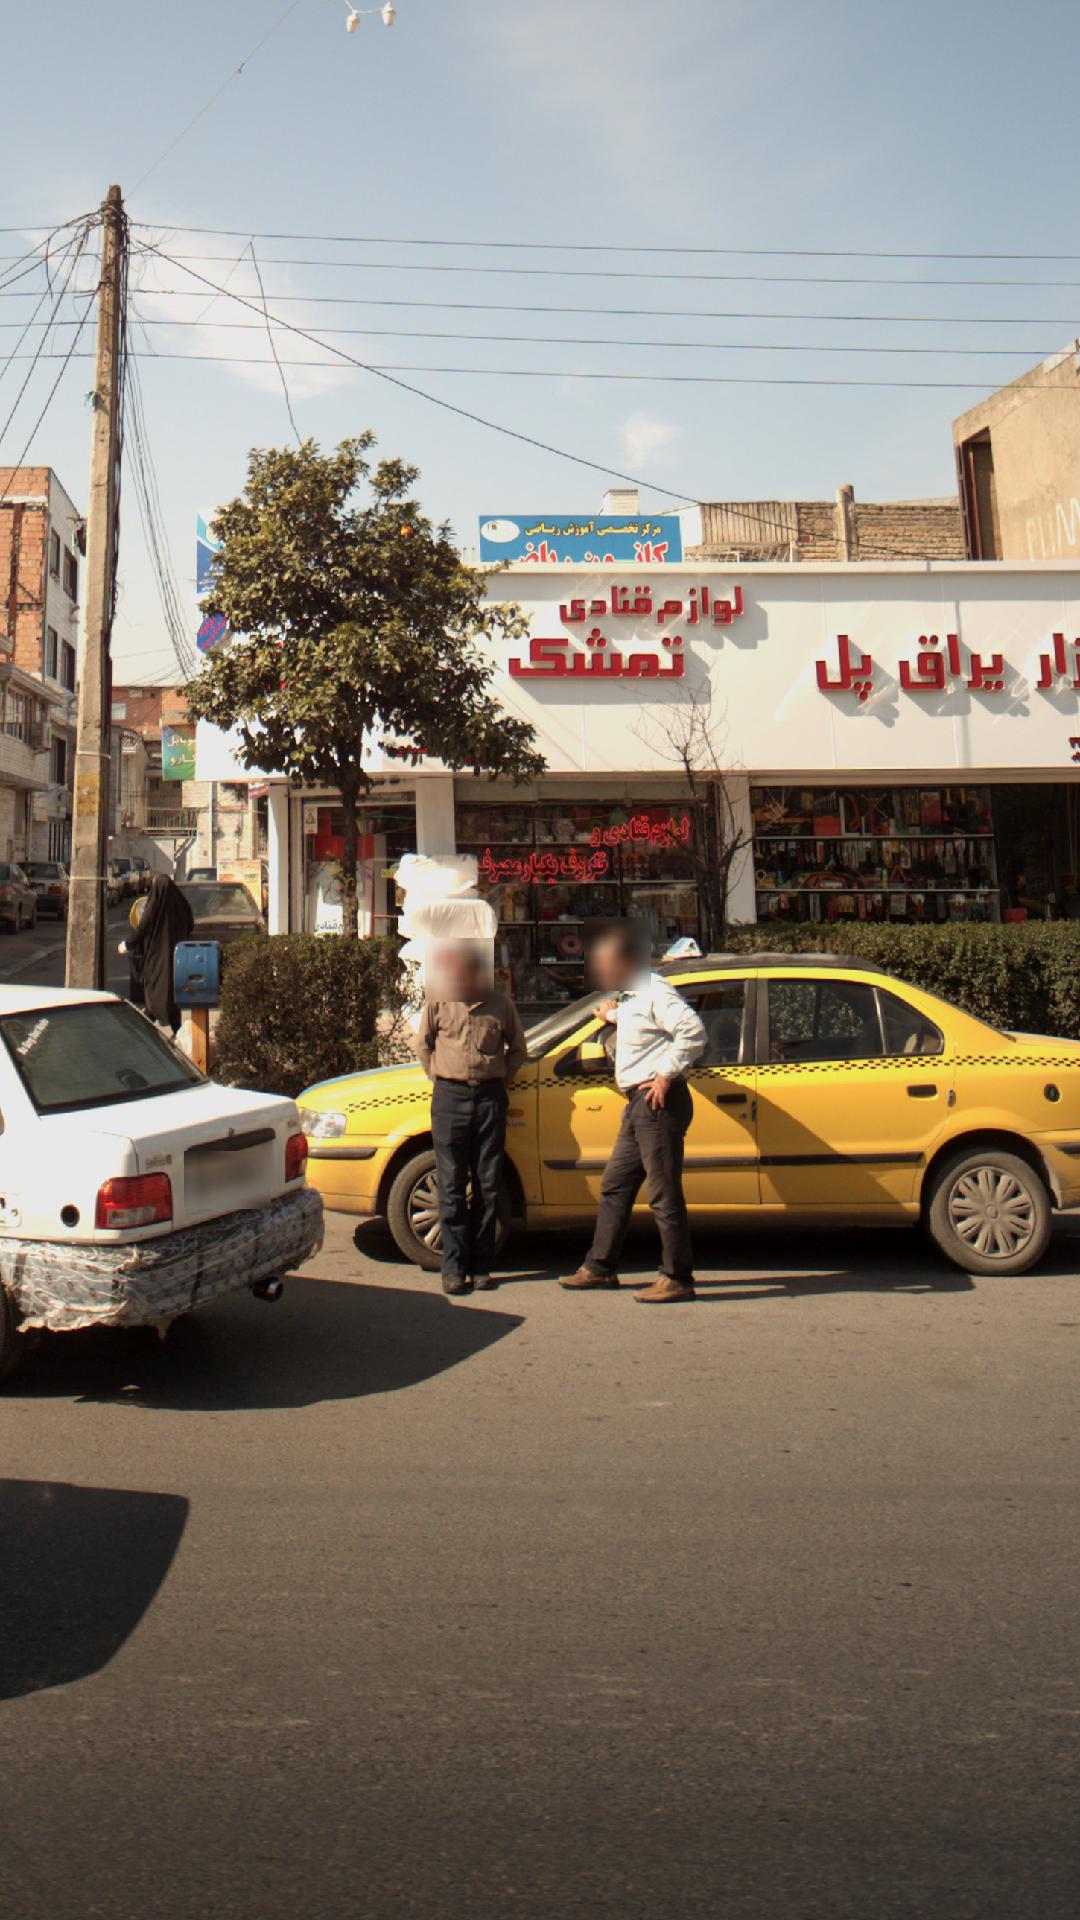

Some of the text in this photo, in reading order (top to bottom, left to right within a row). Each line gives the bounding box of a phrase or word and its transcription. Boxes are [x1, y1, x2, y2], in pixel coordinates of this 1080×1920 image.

[525, 520, 661, 538] مرکز تخصصی آموزش ریاضی
[560, 586, 743, 625] لوازم قنادی
[508, 628, 685, 678] تمشک
[815, 634, 874, 702] پل
[898, 634, 1004, 691] یراق
[590, 816, 691, 848] لوازم قنادی و
